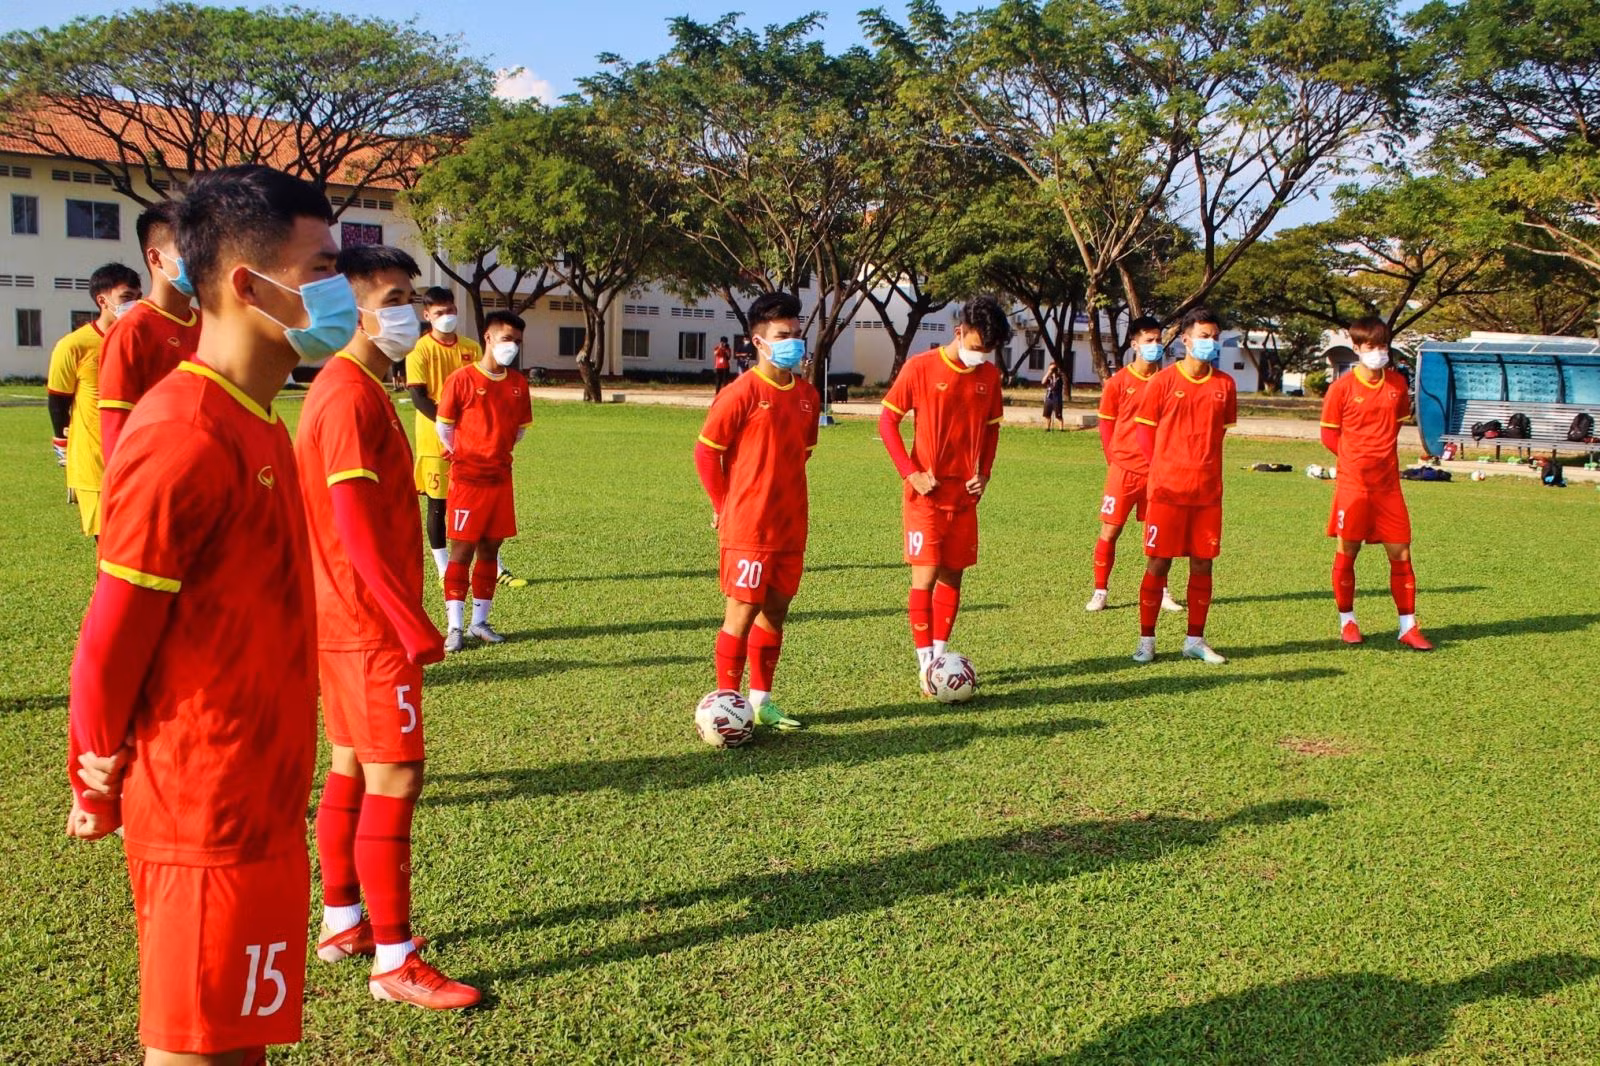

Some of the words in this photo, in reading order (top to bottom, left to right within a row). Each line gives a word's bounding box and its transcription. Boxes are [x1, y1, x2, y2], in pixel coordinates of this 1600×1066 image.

[428, 472, 440, 490] 25
[1101, 496, 1116, 514] 23
[454, 509, 470, 531] 17
[908, 531, 923, 556] 19
[736, 559, 762, 588] 20
[396, 684, 416, 733] 5
[240, 941, 287, 1016] 15
